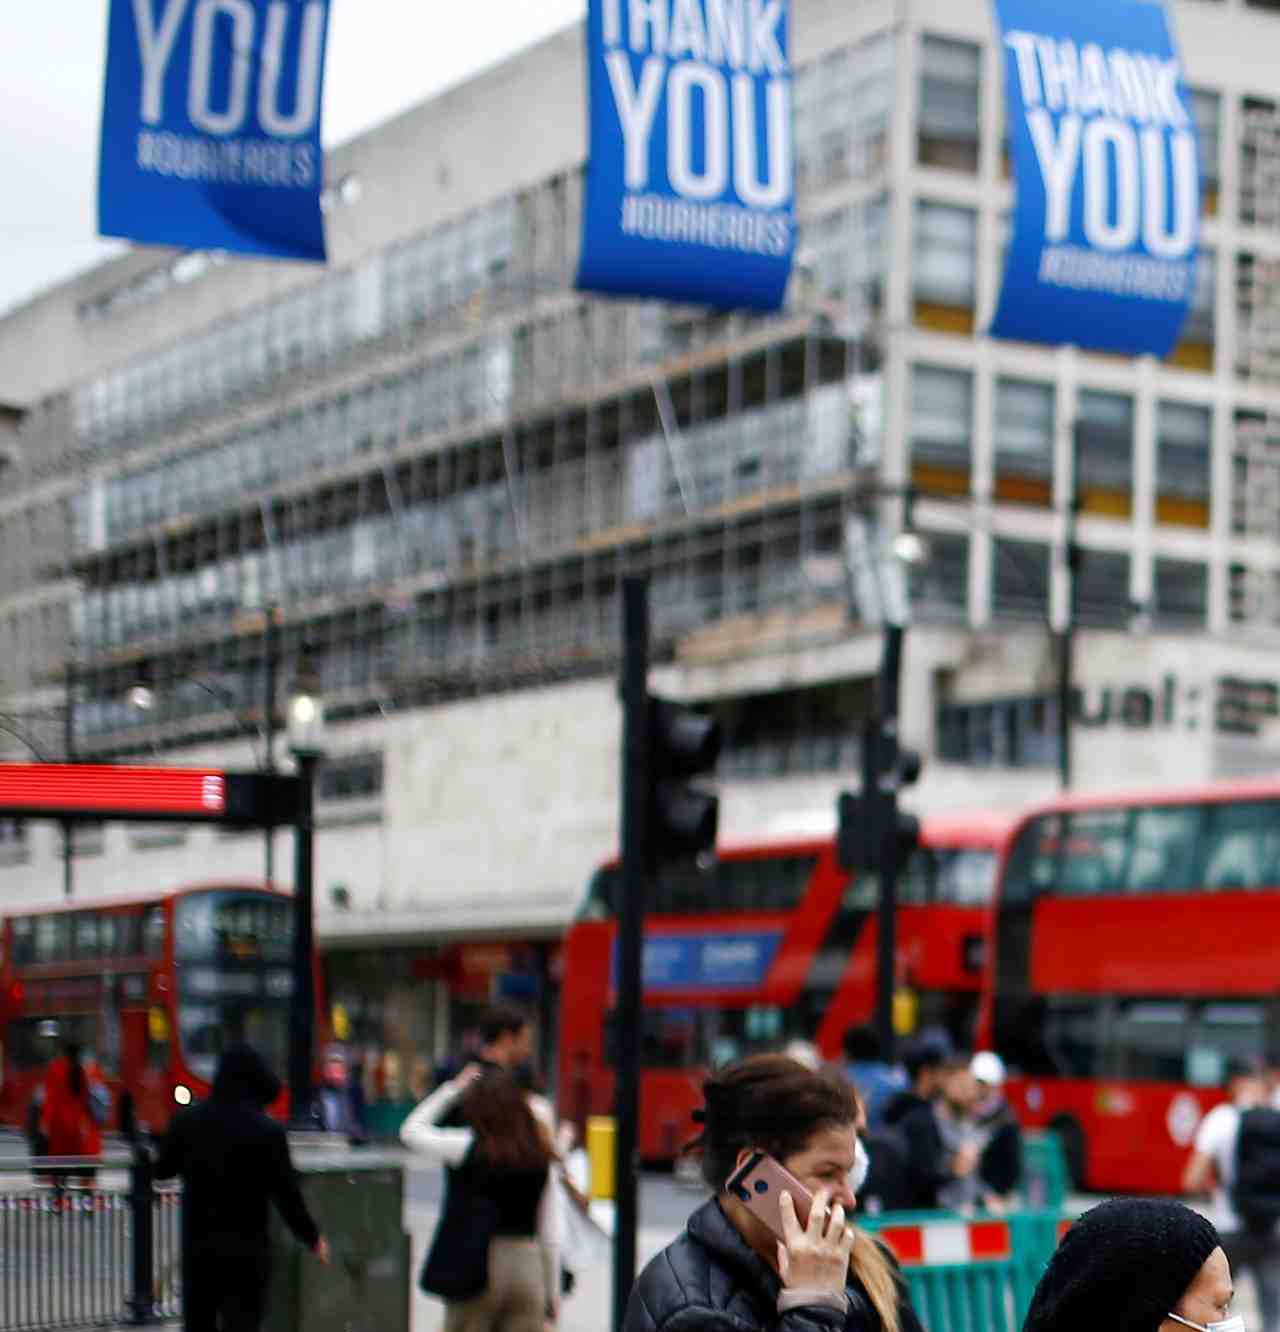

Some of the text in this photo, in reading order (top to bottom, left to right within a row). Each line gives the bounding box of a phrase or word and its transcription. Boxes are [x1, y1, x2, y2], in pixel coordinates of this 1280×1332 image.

[132, 0, 326, 135] YOU
[603, 50, 794, 208] YOU
[1003, 30, 1193, 128] THANK
[1024, 107, 1199, 260] YOU
